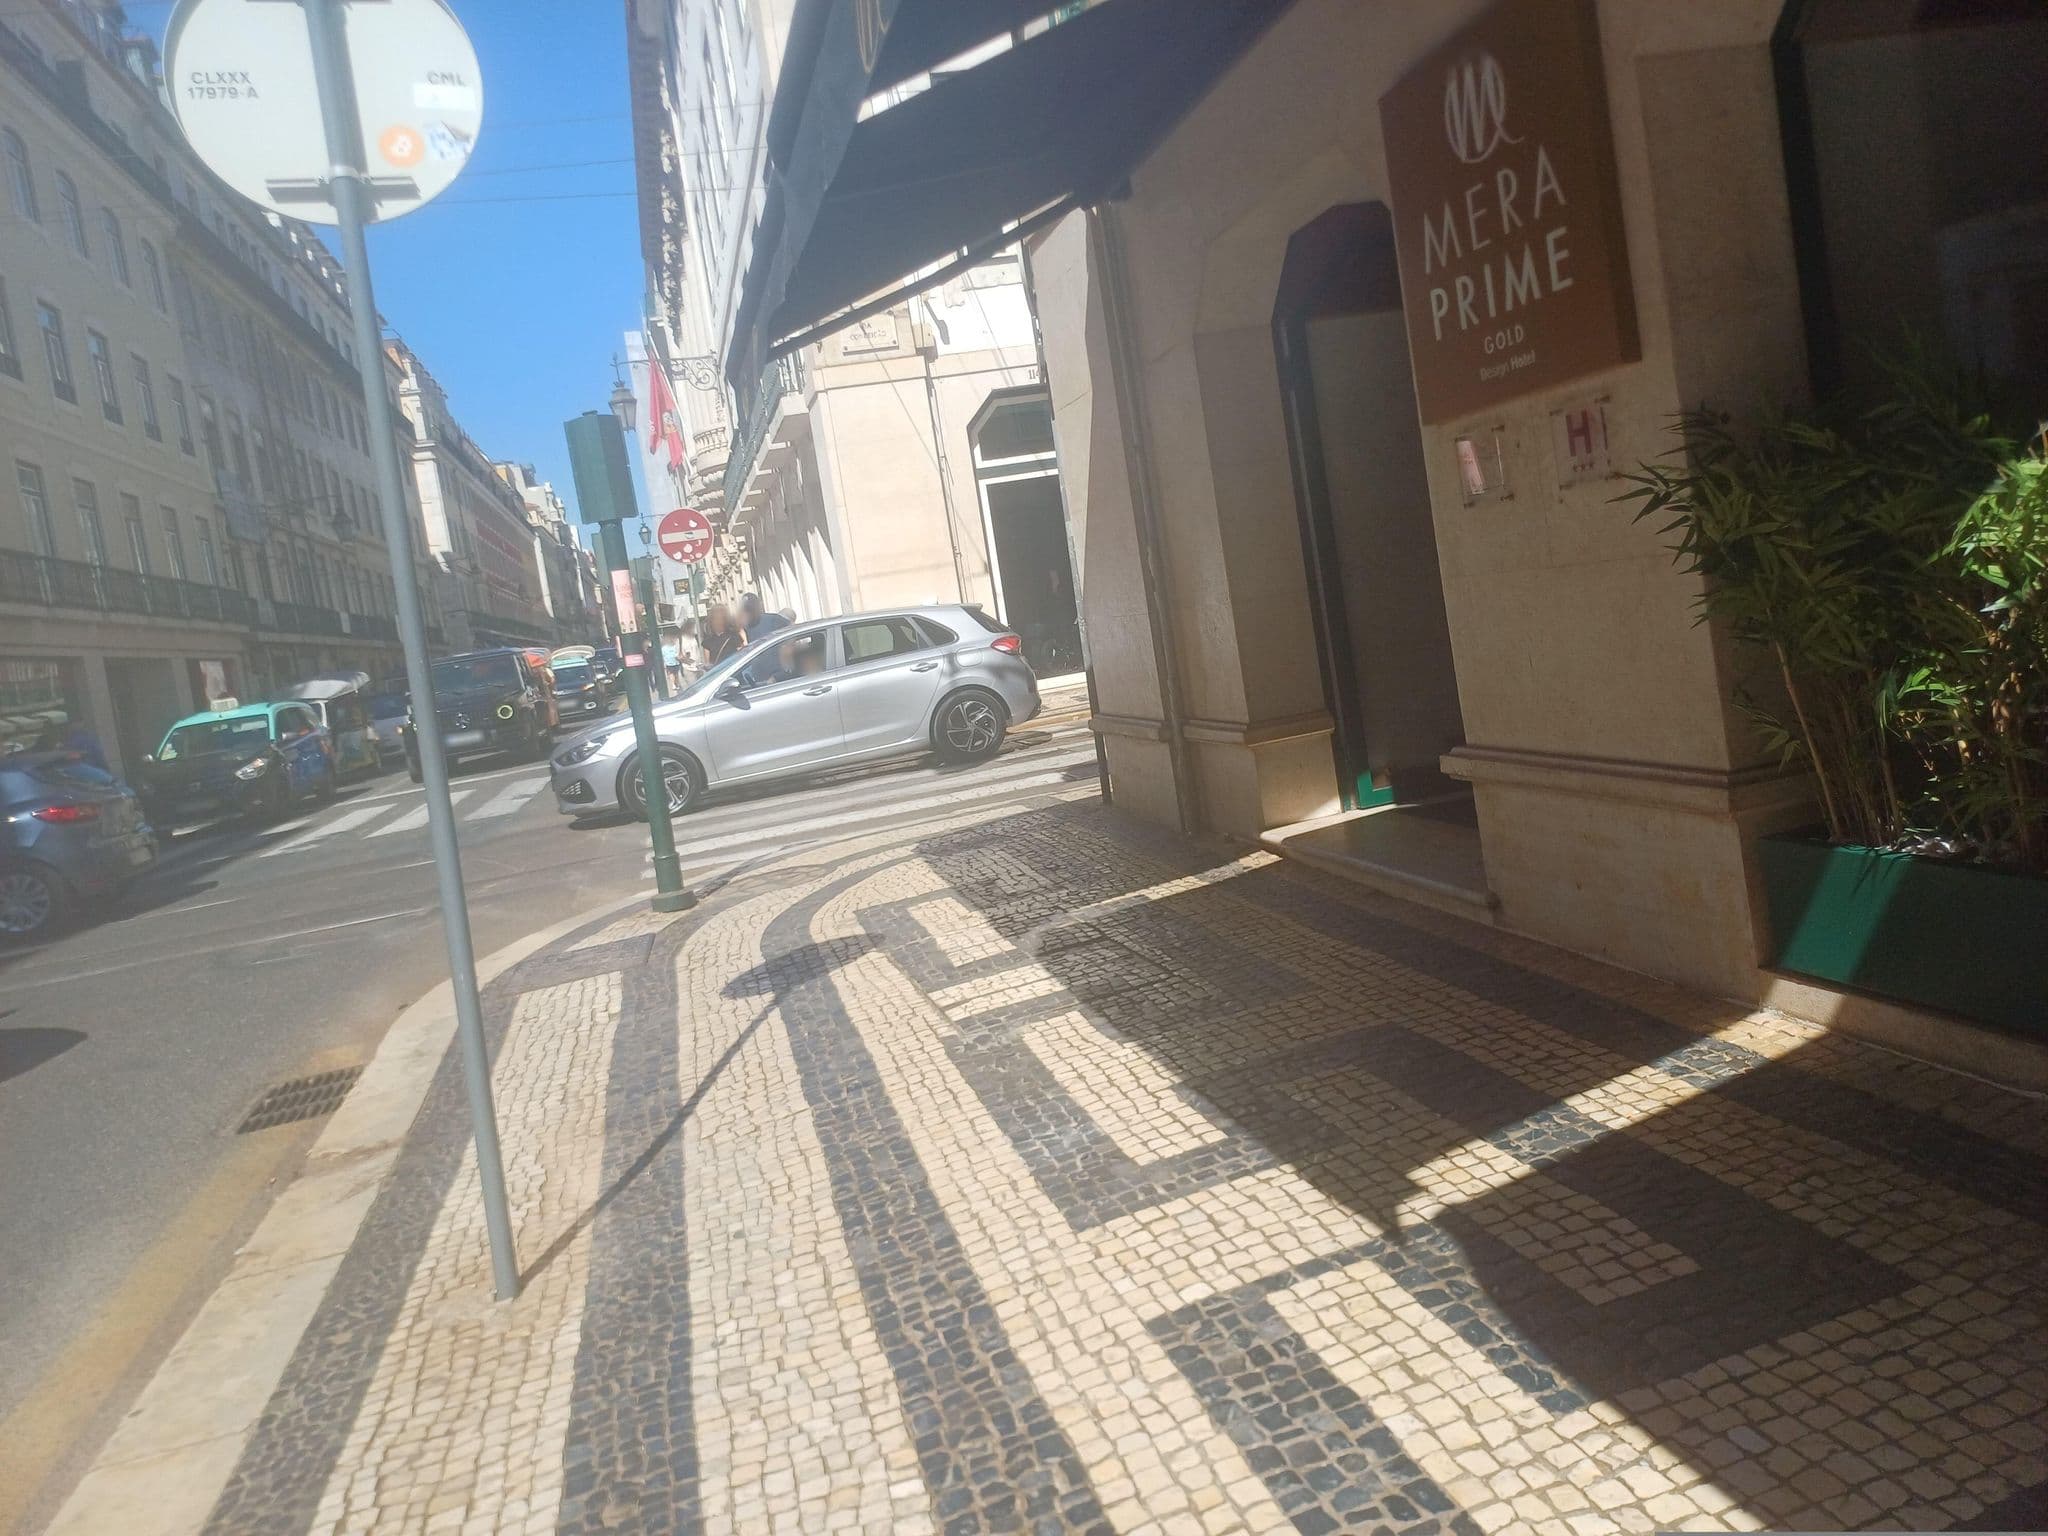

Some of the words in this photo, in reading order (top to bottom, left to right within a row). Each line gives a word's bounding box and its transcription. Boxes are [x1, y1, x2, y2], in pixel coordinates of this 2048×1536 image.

[191, 71, 252, 85] CLXXX
[426, 70, 466, 87] CML
[187, 86, 259, 100] 17979-A
[1424, 144, 1568, 275] MERA
[1430, 226, 1574, 342] PRIME
[1483, 323, 1526, 355] GOLD
[1510, 349, 1536, 370] Hotel
[1565, 408, 1592, 457] H
